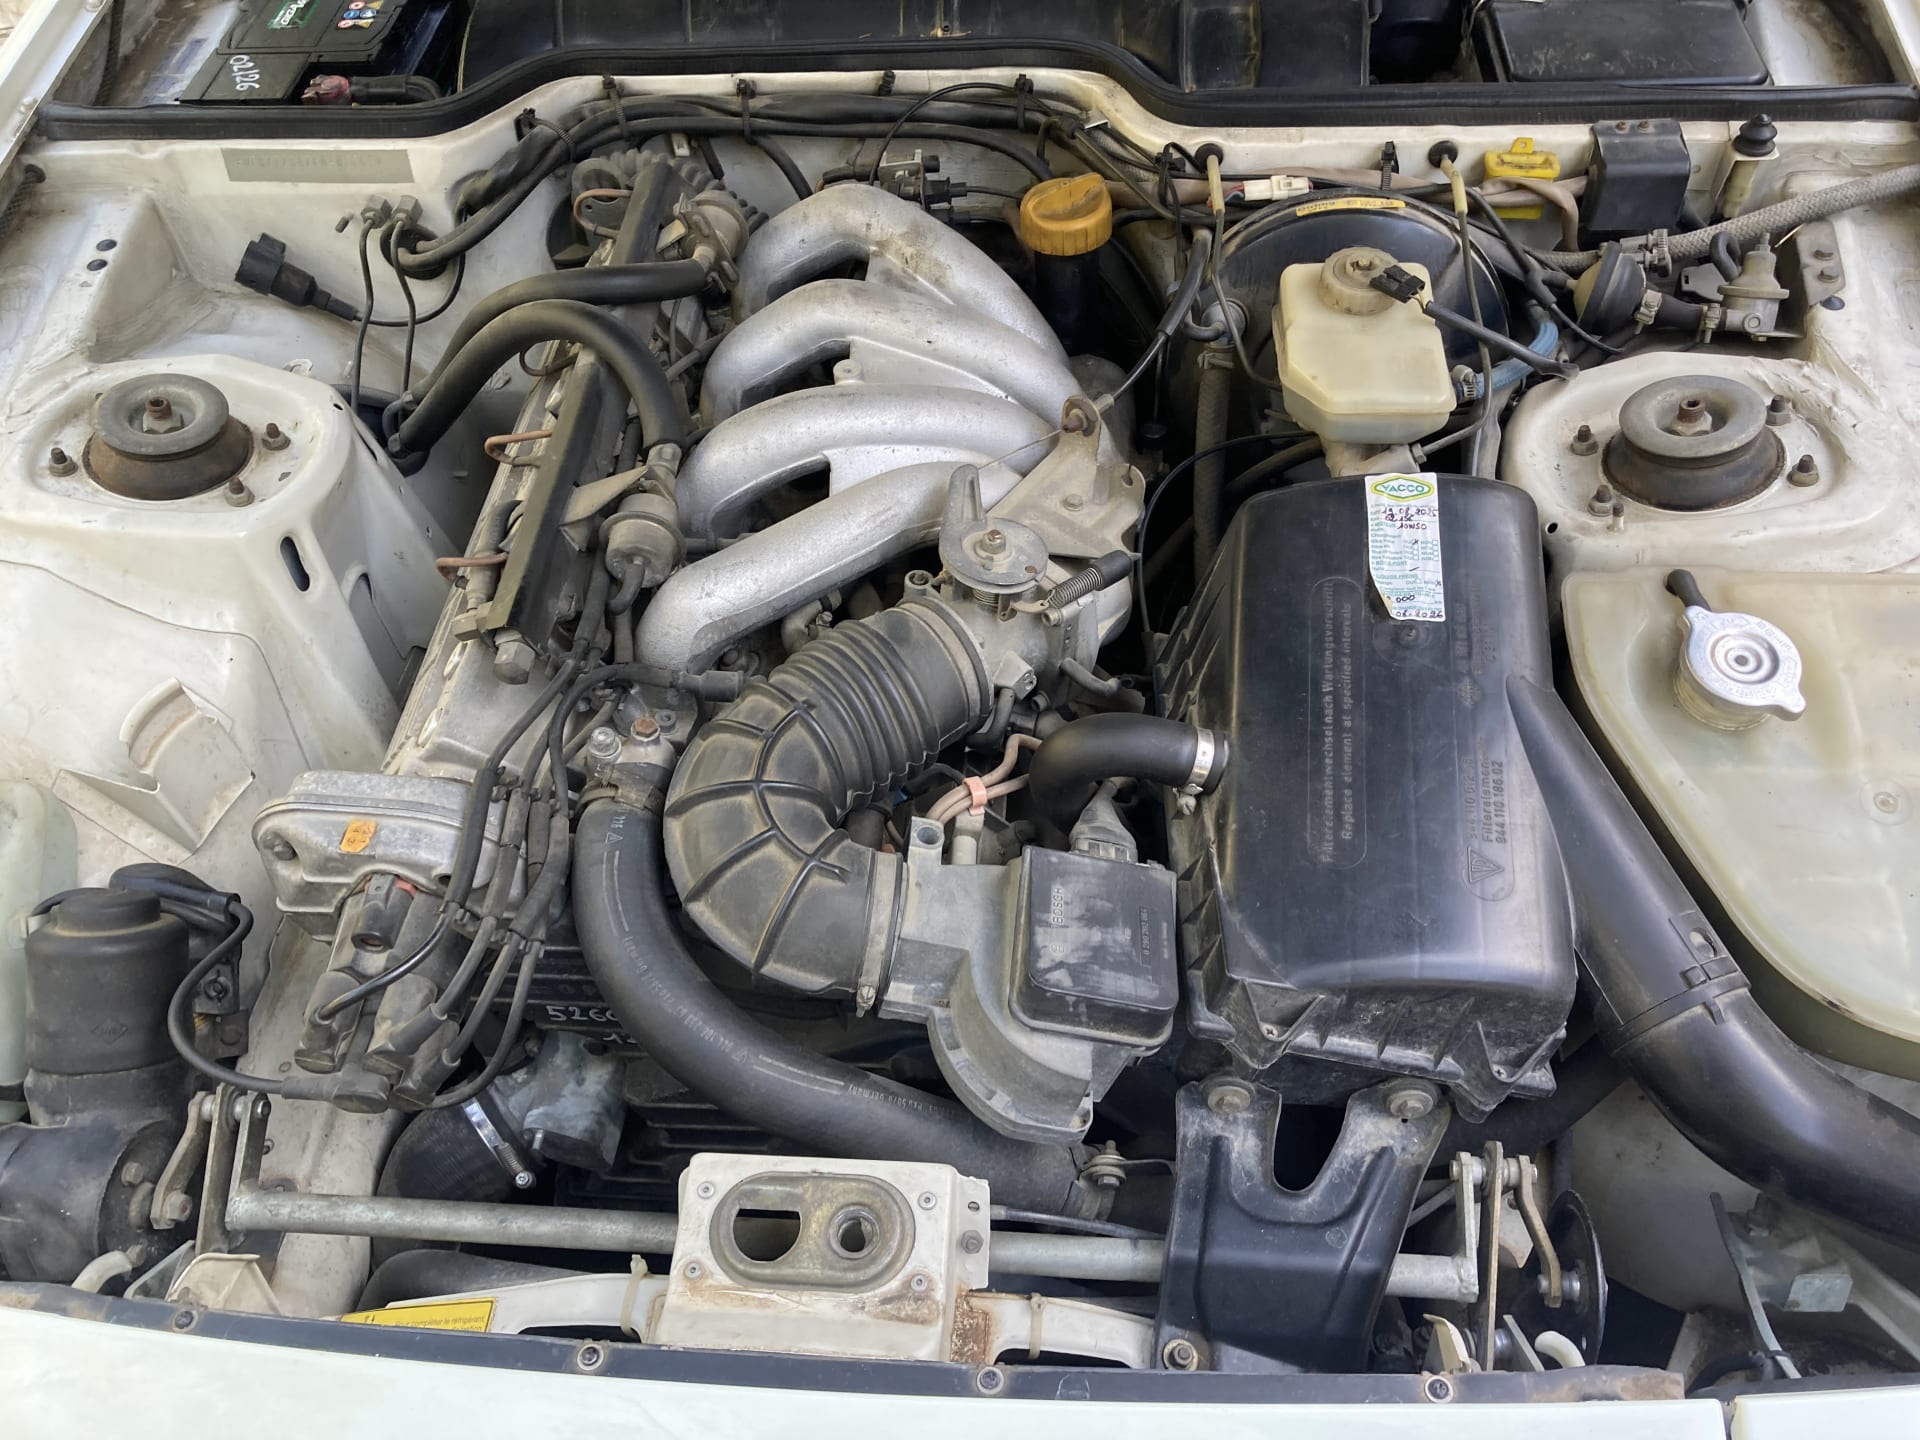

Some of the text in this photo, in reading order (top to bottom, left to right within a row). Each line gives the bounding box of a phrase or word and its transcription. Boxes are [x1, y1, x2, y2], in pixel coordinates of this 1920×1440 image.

[1382, 484, 1425, 493] YACCO
[1322, 695, 1334, 723] nach
[1341, 602, 1355, 839] Replace element at specified intervals
[1491, 760, 1507, 844] 944.110.186.02
[1052, 887, 1064, 925] BOSCH
